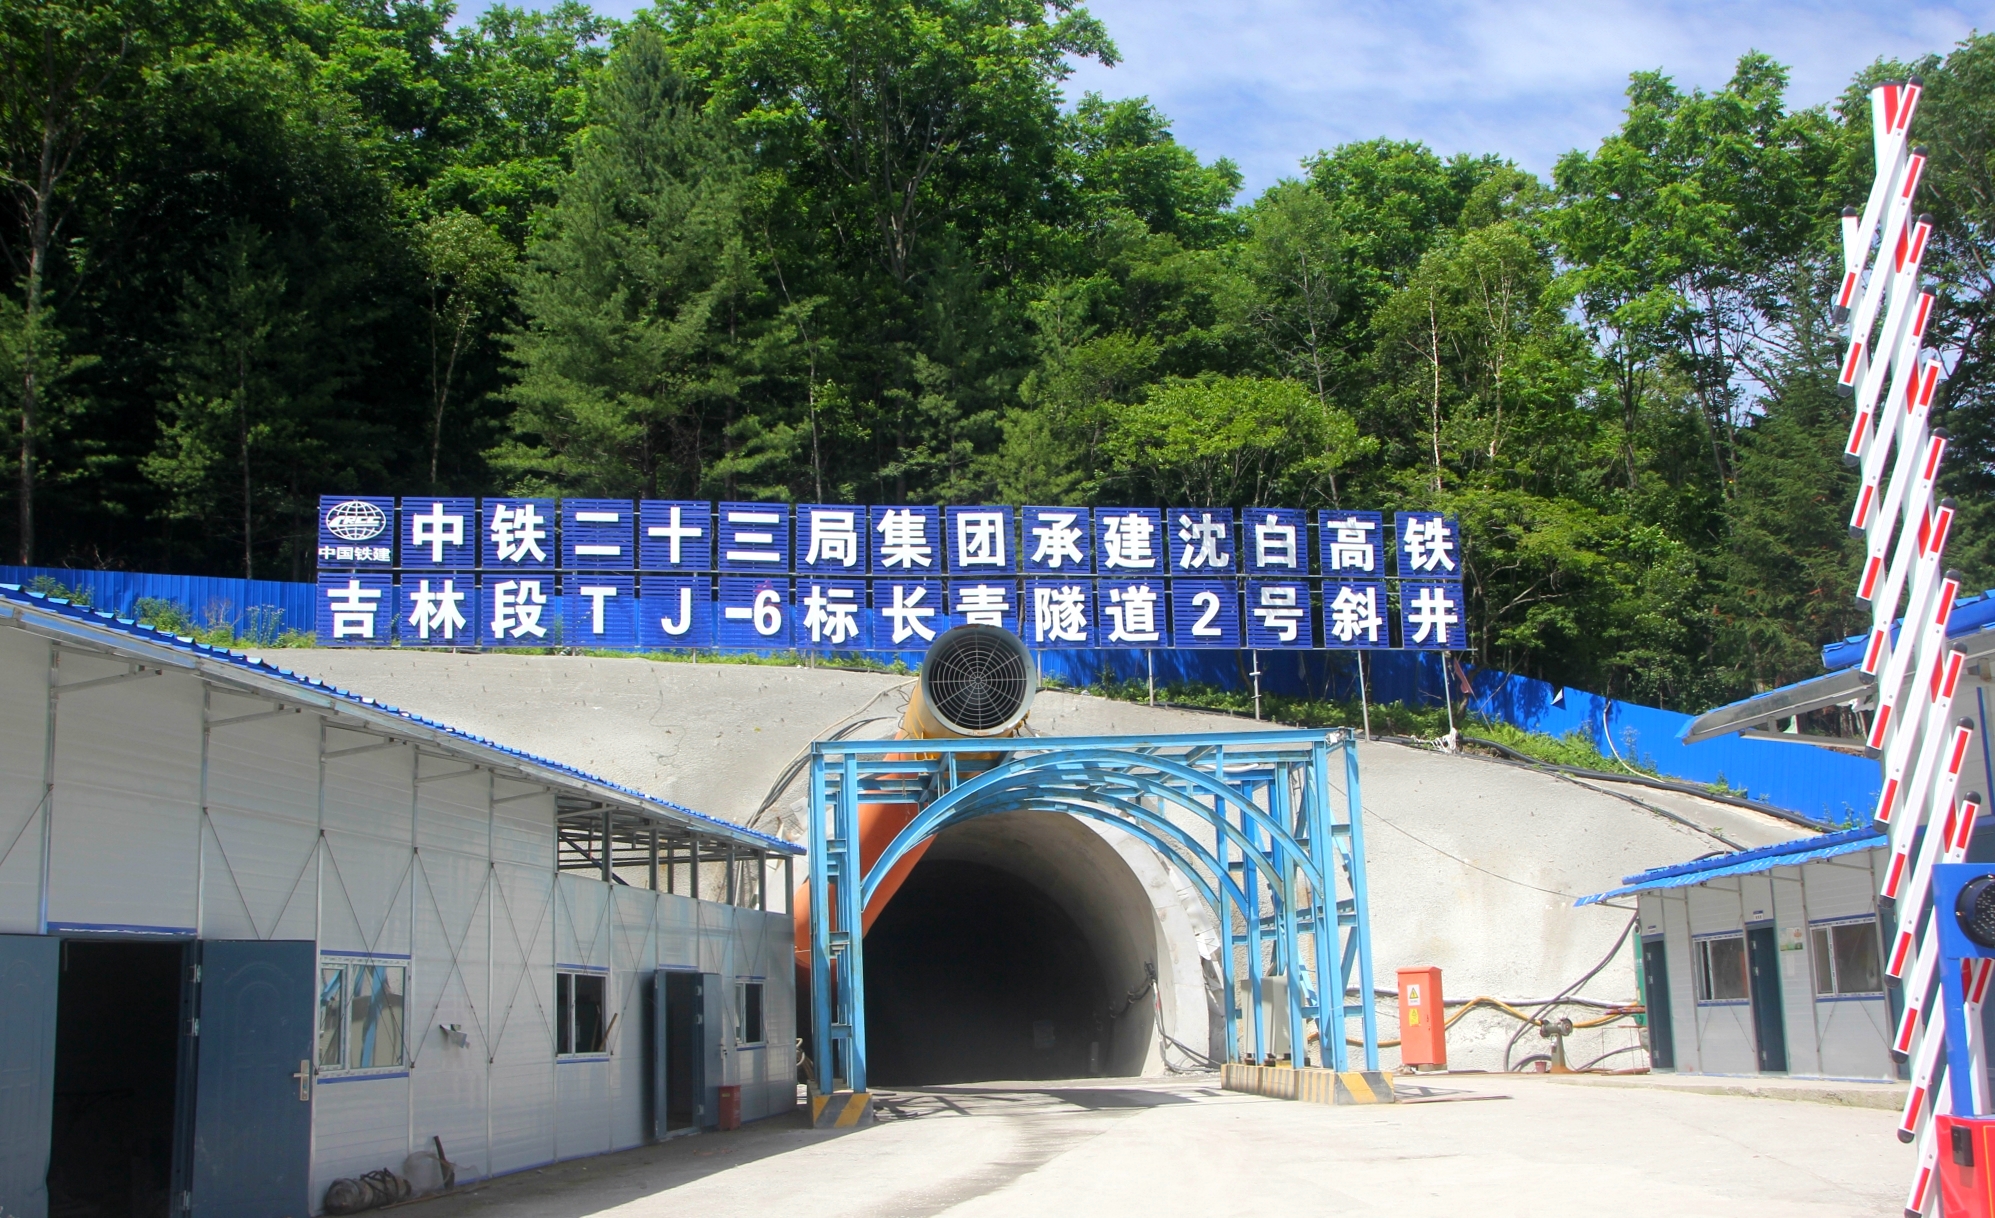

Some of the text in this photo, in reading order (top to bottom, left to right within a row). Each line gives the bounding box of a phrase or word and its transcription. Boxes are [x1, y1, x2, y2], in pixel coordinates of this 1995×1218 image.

[329, 515, 381, 527] CRCC
[412, 502, 1457, 573] 中铁二十三局集团承建沈白高铁
[318, 546, 391, 562] 中国铁建
